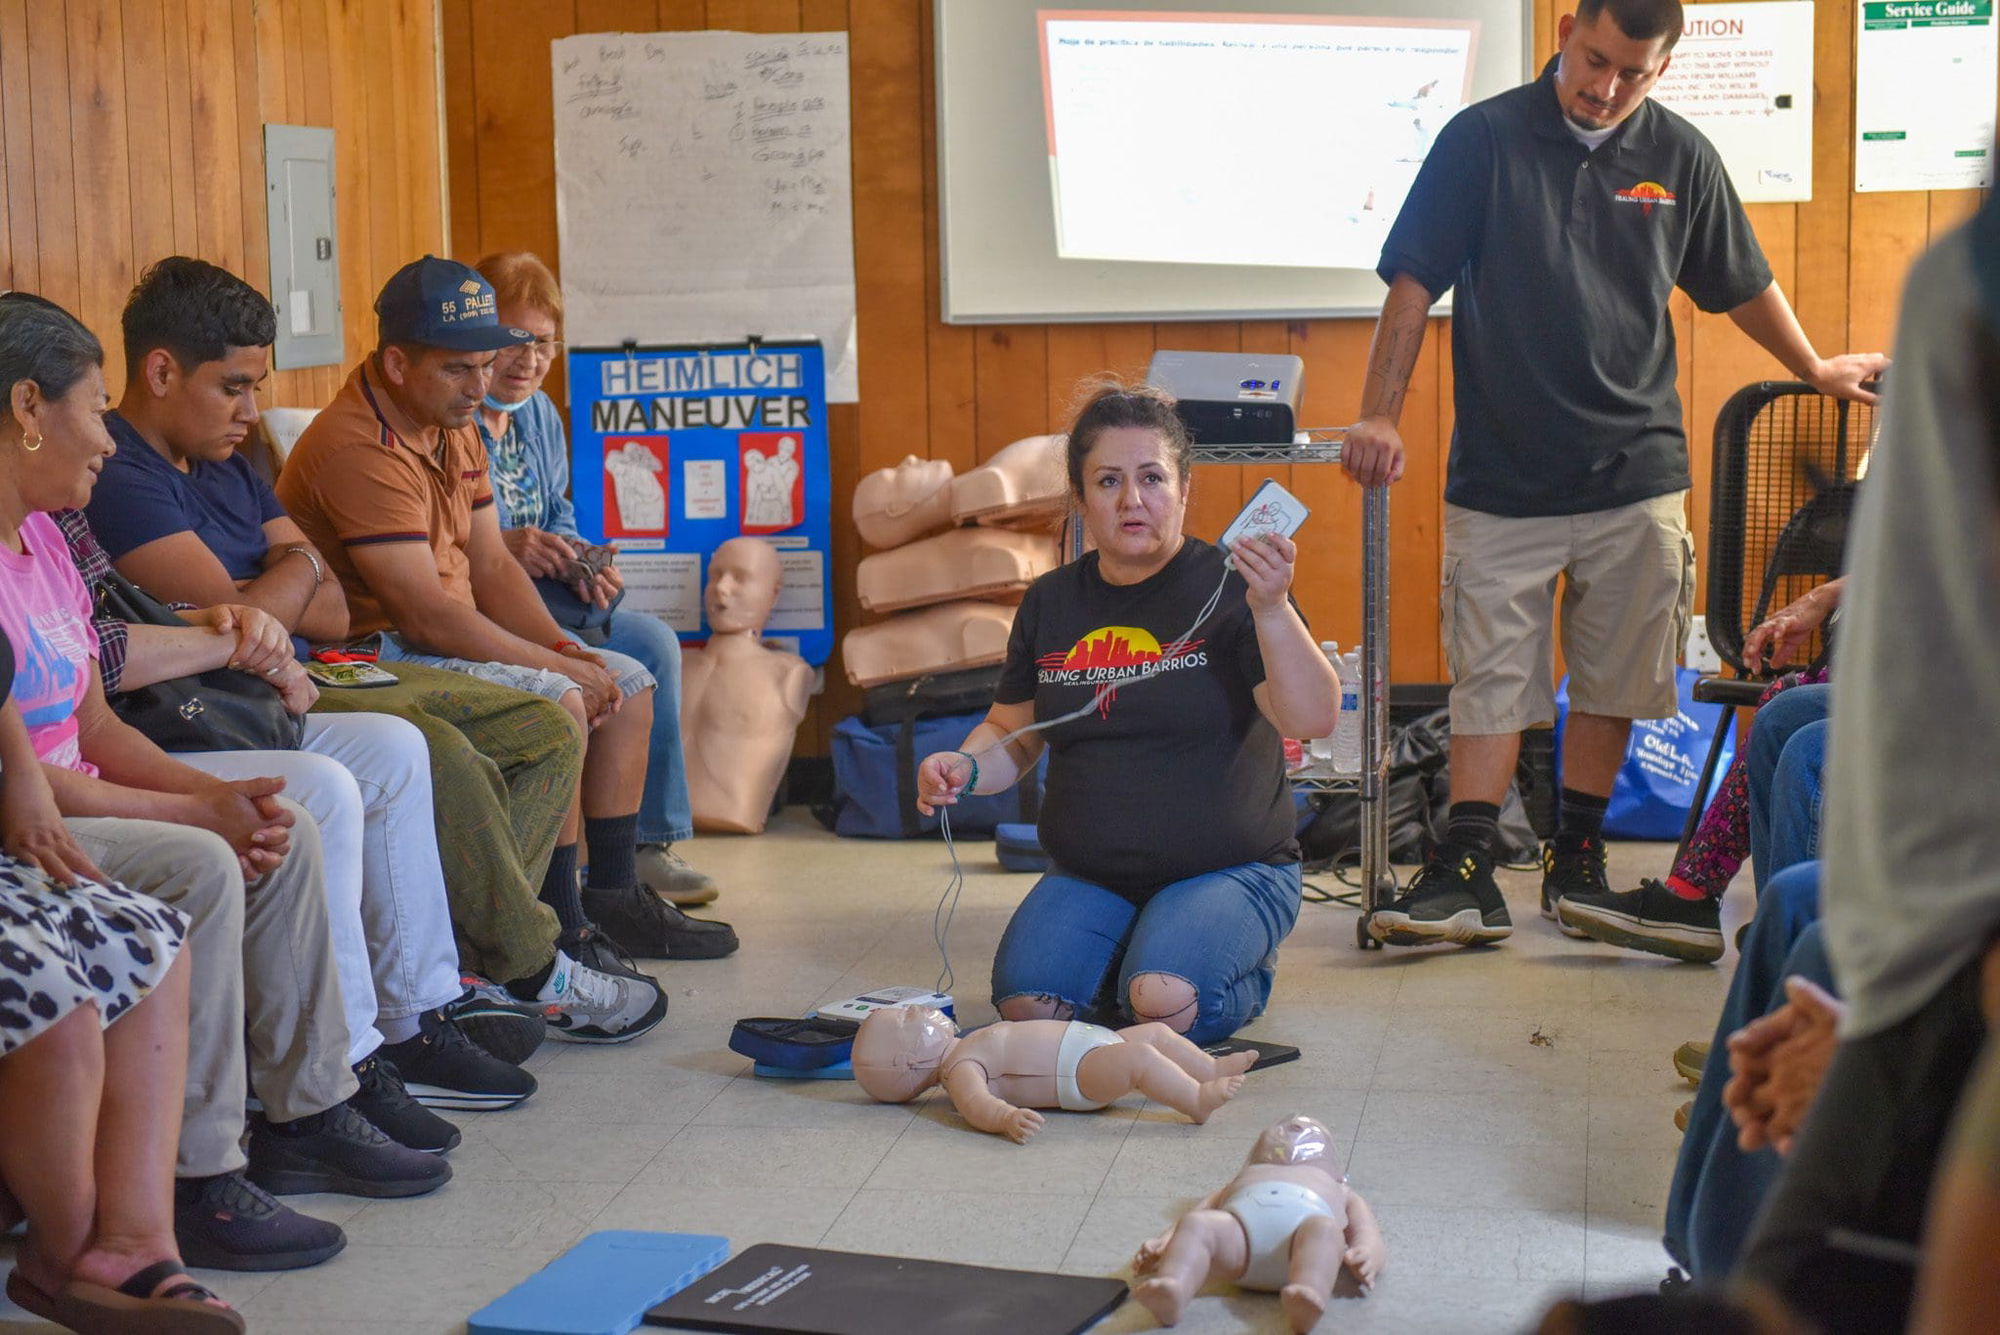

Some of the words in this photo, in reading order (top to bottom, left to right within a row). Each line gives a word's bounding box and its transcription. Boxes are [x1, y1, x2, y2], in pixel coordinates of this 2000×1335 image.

[1885, 3, 1933, 17] Service
[1935, 1, 1977, 16] Guide
[1683, 19, 1743, 37] UTION
[442, 301, 456, 314] 55
[605, 355, 803, 393] HEIMLICH
[591, 396, 812, 433] MANEUVER
[1086, 665, 1137, 681] URBAN
[1142, 652, 1208, 675] BARRIOS
[1643, 733, 1669, 757] Old
